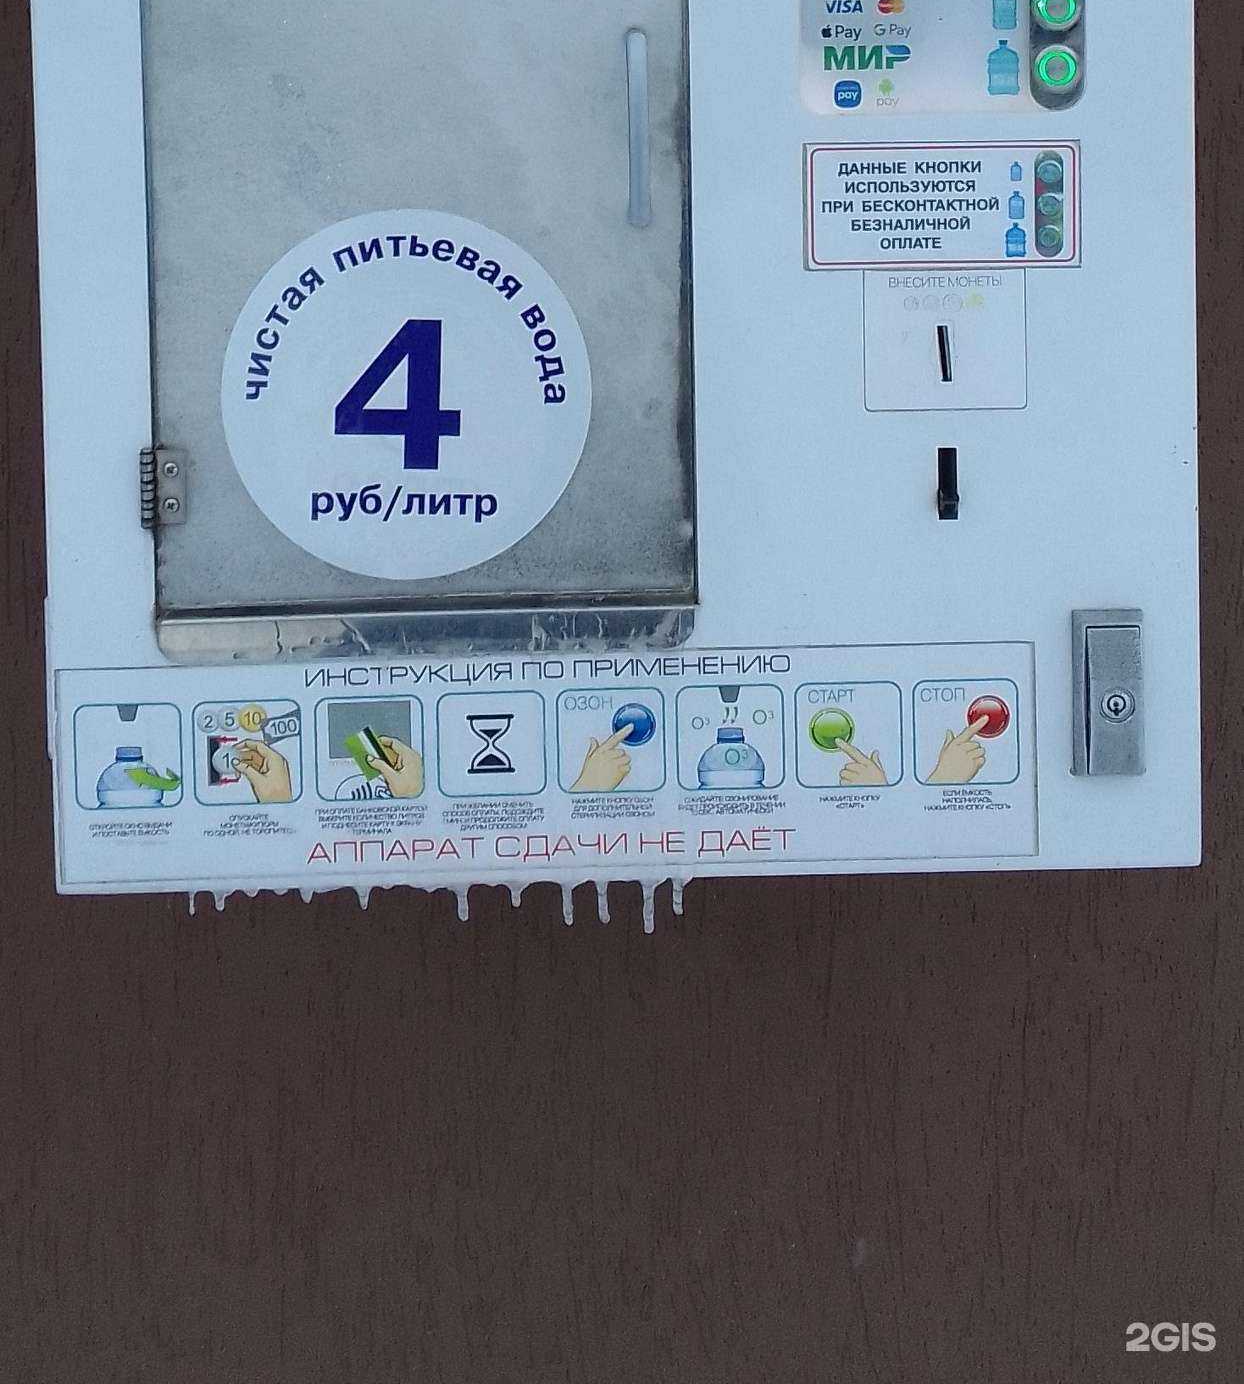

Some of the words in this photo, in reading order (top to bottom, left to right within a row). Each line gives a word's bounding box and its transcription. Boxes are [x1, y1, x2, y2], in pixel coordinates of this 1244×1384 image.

[825, 0, 863, 14] VISA
[835, 25, 862, 41] Pay
[889, 24, 912, 39] Pay
[823, 44, 912, 71] МИР
[838, 91, 859, 101] pay
[877, 97, 899, 107] pay
[838, 162, 906, 177] ДАННЫЕ
[914, 160, 982, 174] КНОПКИ
[845, 180, 976, 194] ИСПОЛЬЗУЮТСЯ
[821, 200, 854, 213] ПРИ
[862, 197, 1000, 213] БЕСКОНТАКТНОЙ
[851, 216, 971, 232] БЕЗНАЛИЧНОЙ
[880, 237, 942, 249] ОПЛАТЕ
[888, 276, 945, 288] ВНЕСИТЕ
[947, 275, 1002, 288] МОНЕТЫ
[245, 266, 325, 401] чистая
[332, 235, 523, 300] питьевая
[520, 304, 566, 405] вода
[334, 319, 461, 469] 4
[310, 483, 498, 522] руб/литр
[304, 661, 513, 688] ИНСТРУКЦИЯ
[521, 660, 564, 680] ПО
[573, 653, 791, 679] ПРИМЕНЕНИЮ
[808, 688, 855, 703] СТАРТ
[920, 687, 965, 702] СТОП
[564, 695, 615, 711] ОЗОН
[204, 715, 213, 729] 2
[225, 712, 235, 726] 5
[244, 712, 261, 726] 10
[270, 719, 297, 735] 100
[307, 837, 484, 864] АППАРАТ
[495, 832, 628, 863] СДАЧИ
[639, 831, 685, 854] НЕ
[698, 826, 797, 858] ДАЁТ
